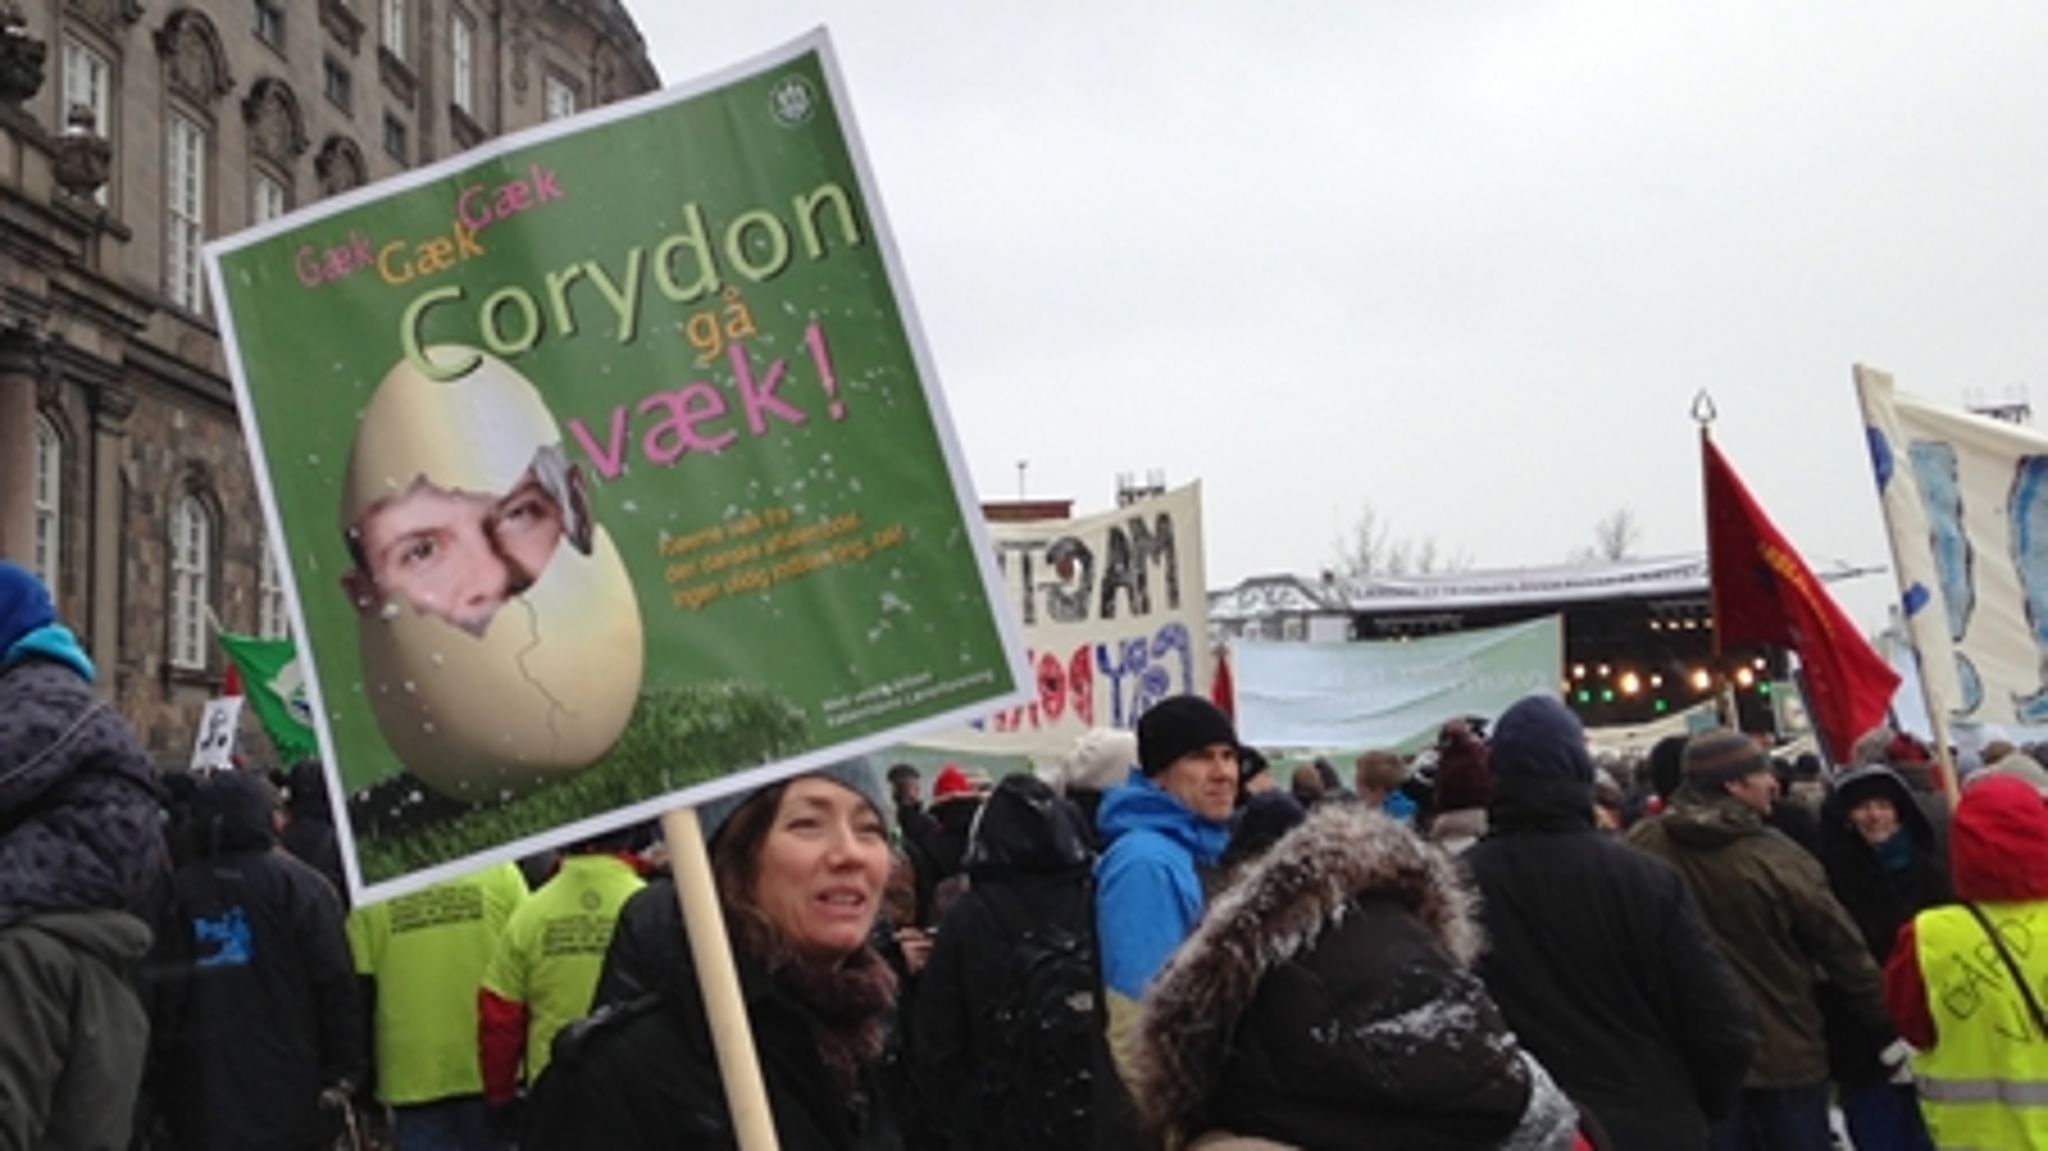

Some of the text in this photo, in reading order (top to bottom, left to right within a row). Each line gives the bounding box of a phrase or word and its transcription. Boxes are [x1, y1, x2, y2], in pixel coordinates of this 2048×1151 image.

[293, 162, 565, 290] Gæk Gæk Gæk
[402, 180, 865, 383] Corydon
[684, 286, 757, 363] gå
